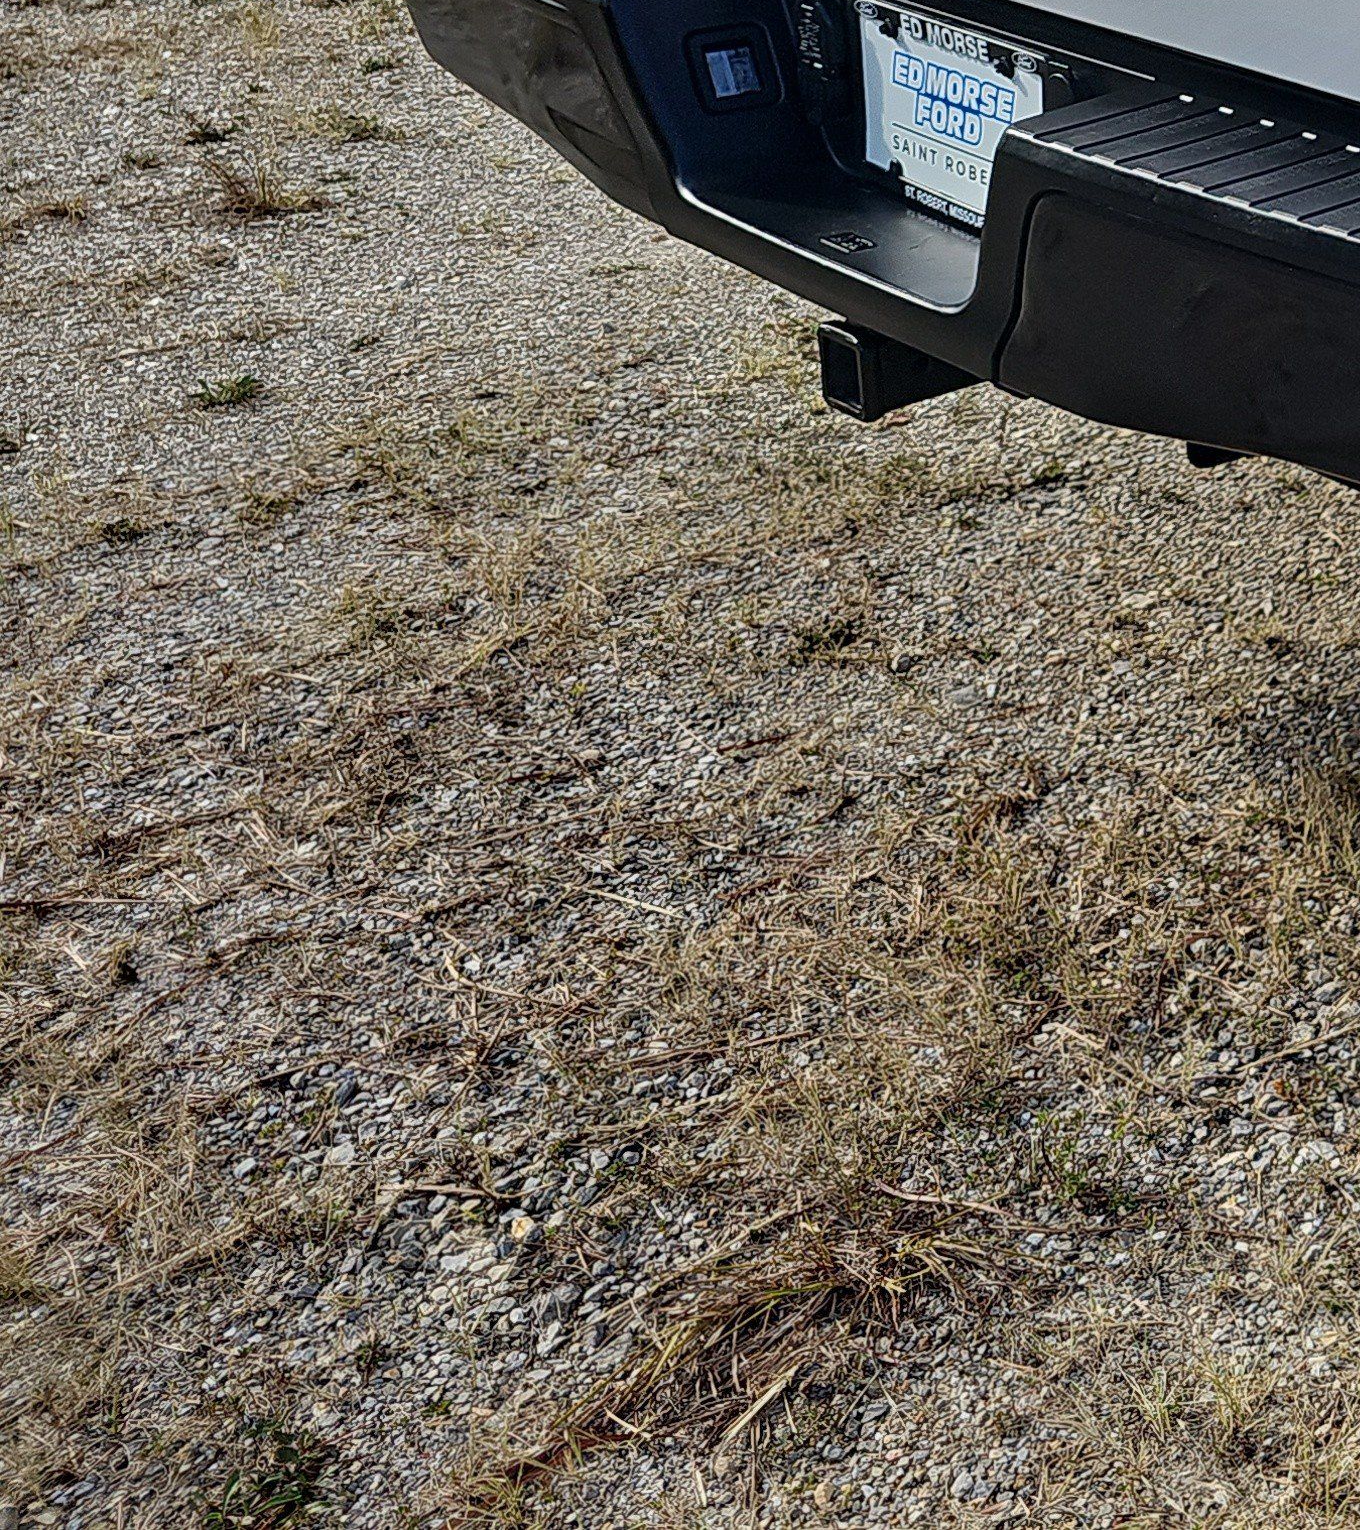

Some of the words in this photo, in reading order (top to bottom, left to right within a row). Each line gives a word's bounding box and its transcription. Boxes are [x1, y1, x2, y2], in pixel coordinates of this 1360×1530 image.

[900, 14, 923, 38] ED
[926, 21, 989, 62] MORSE
[892, 50, 925, 93] ED
[925, 61, 1015, 122] MORSE
[914, 92, 983, 146] FORD
[892, 134, 938, 167] SAINT
